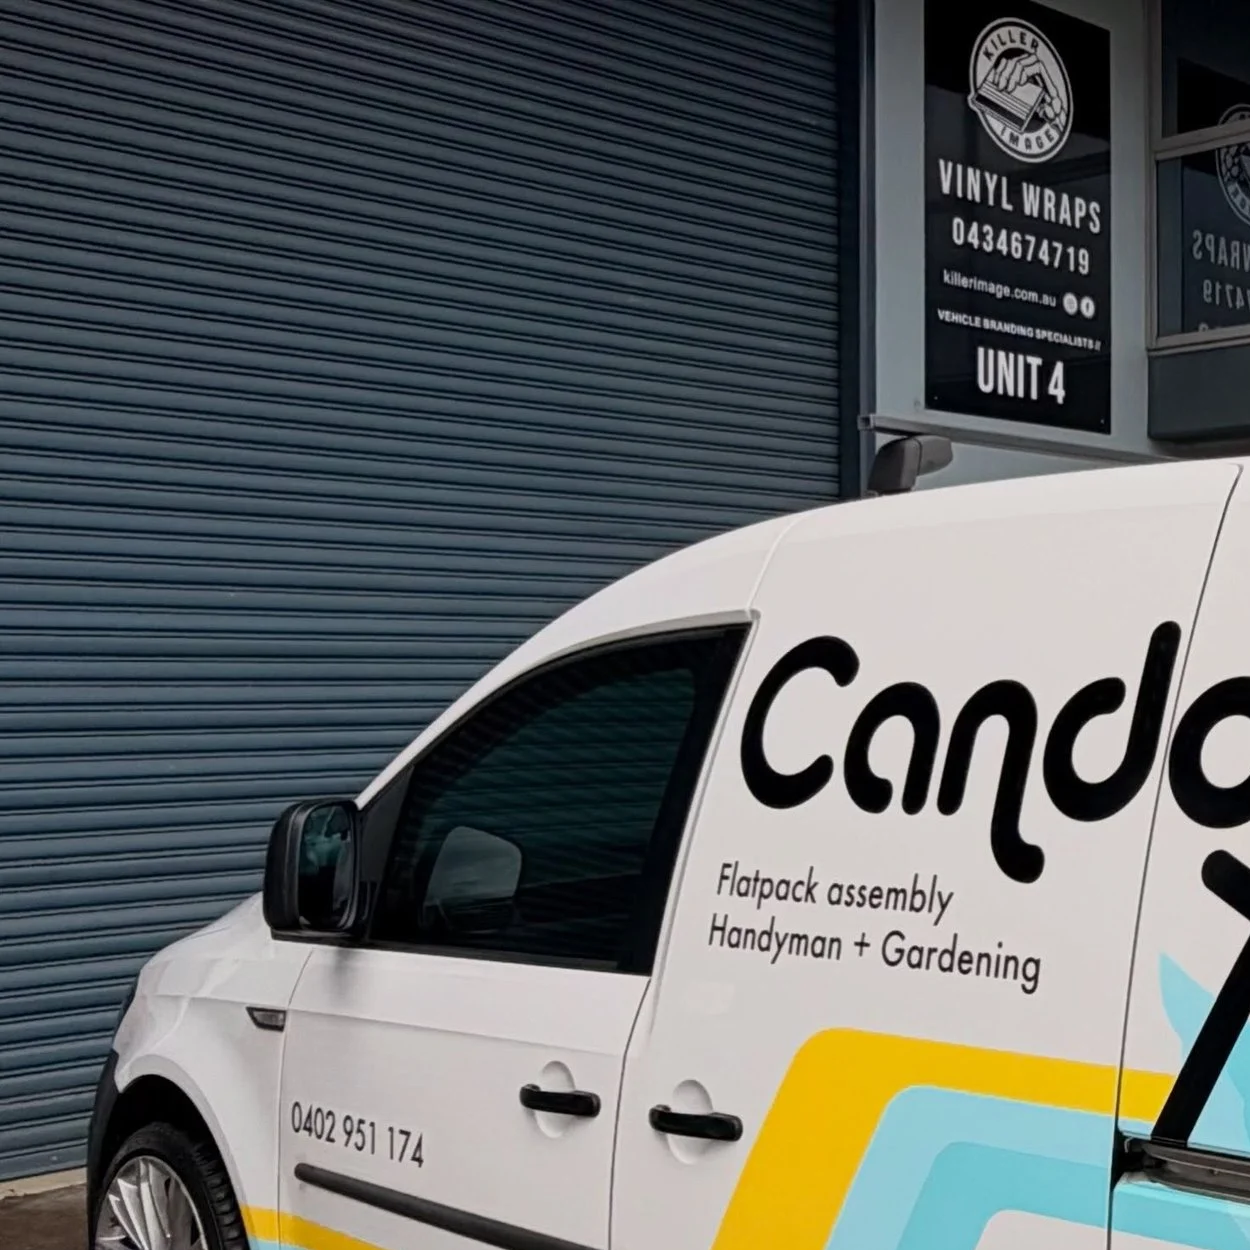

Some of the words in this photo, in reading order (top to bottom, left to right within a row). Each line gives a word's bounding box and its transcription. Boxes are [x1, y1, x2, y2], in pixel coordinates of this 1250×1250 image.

[982, 29, 1039, 61] KILLER
[1000, 126, 1055, 151] IMAGE
[939, 159, 1013, 211] VINYL
[1022, 181, 1101, 234] WRAPS
[952, 217, 1090, 275] 0434674719
[943, 269, 1057, 307] killerimage.com.au
[937, 308, 982, 328] VEHICLE
[983, 317, 1034, 339] BRANDING
[1035, 329, 1095, 350] SPECIALISTS
[976, 346, 1043, 401] UNIT
[1048, 360, 1066, 405] 4
[716, 860, 819, 910] Flatpack
[827, 873, 954, 926] assembly
[708, 913, 842, 965] Handyman
[881, 929, 1041, 995] Gardening
[291, 1101, 336, 1144] 0402
[343, 1114, 377, 1155] 951
[388, 1126, 424, 1168] 174
